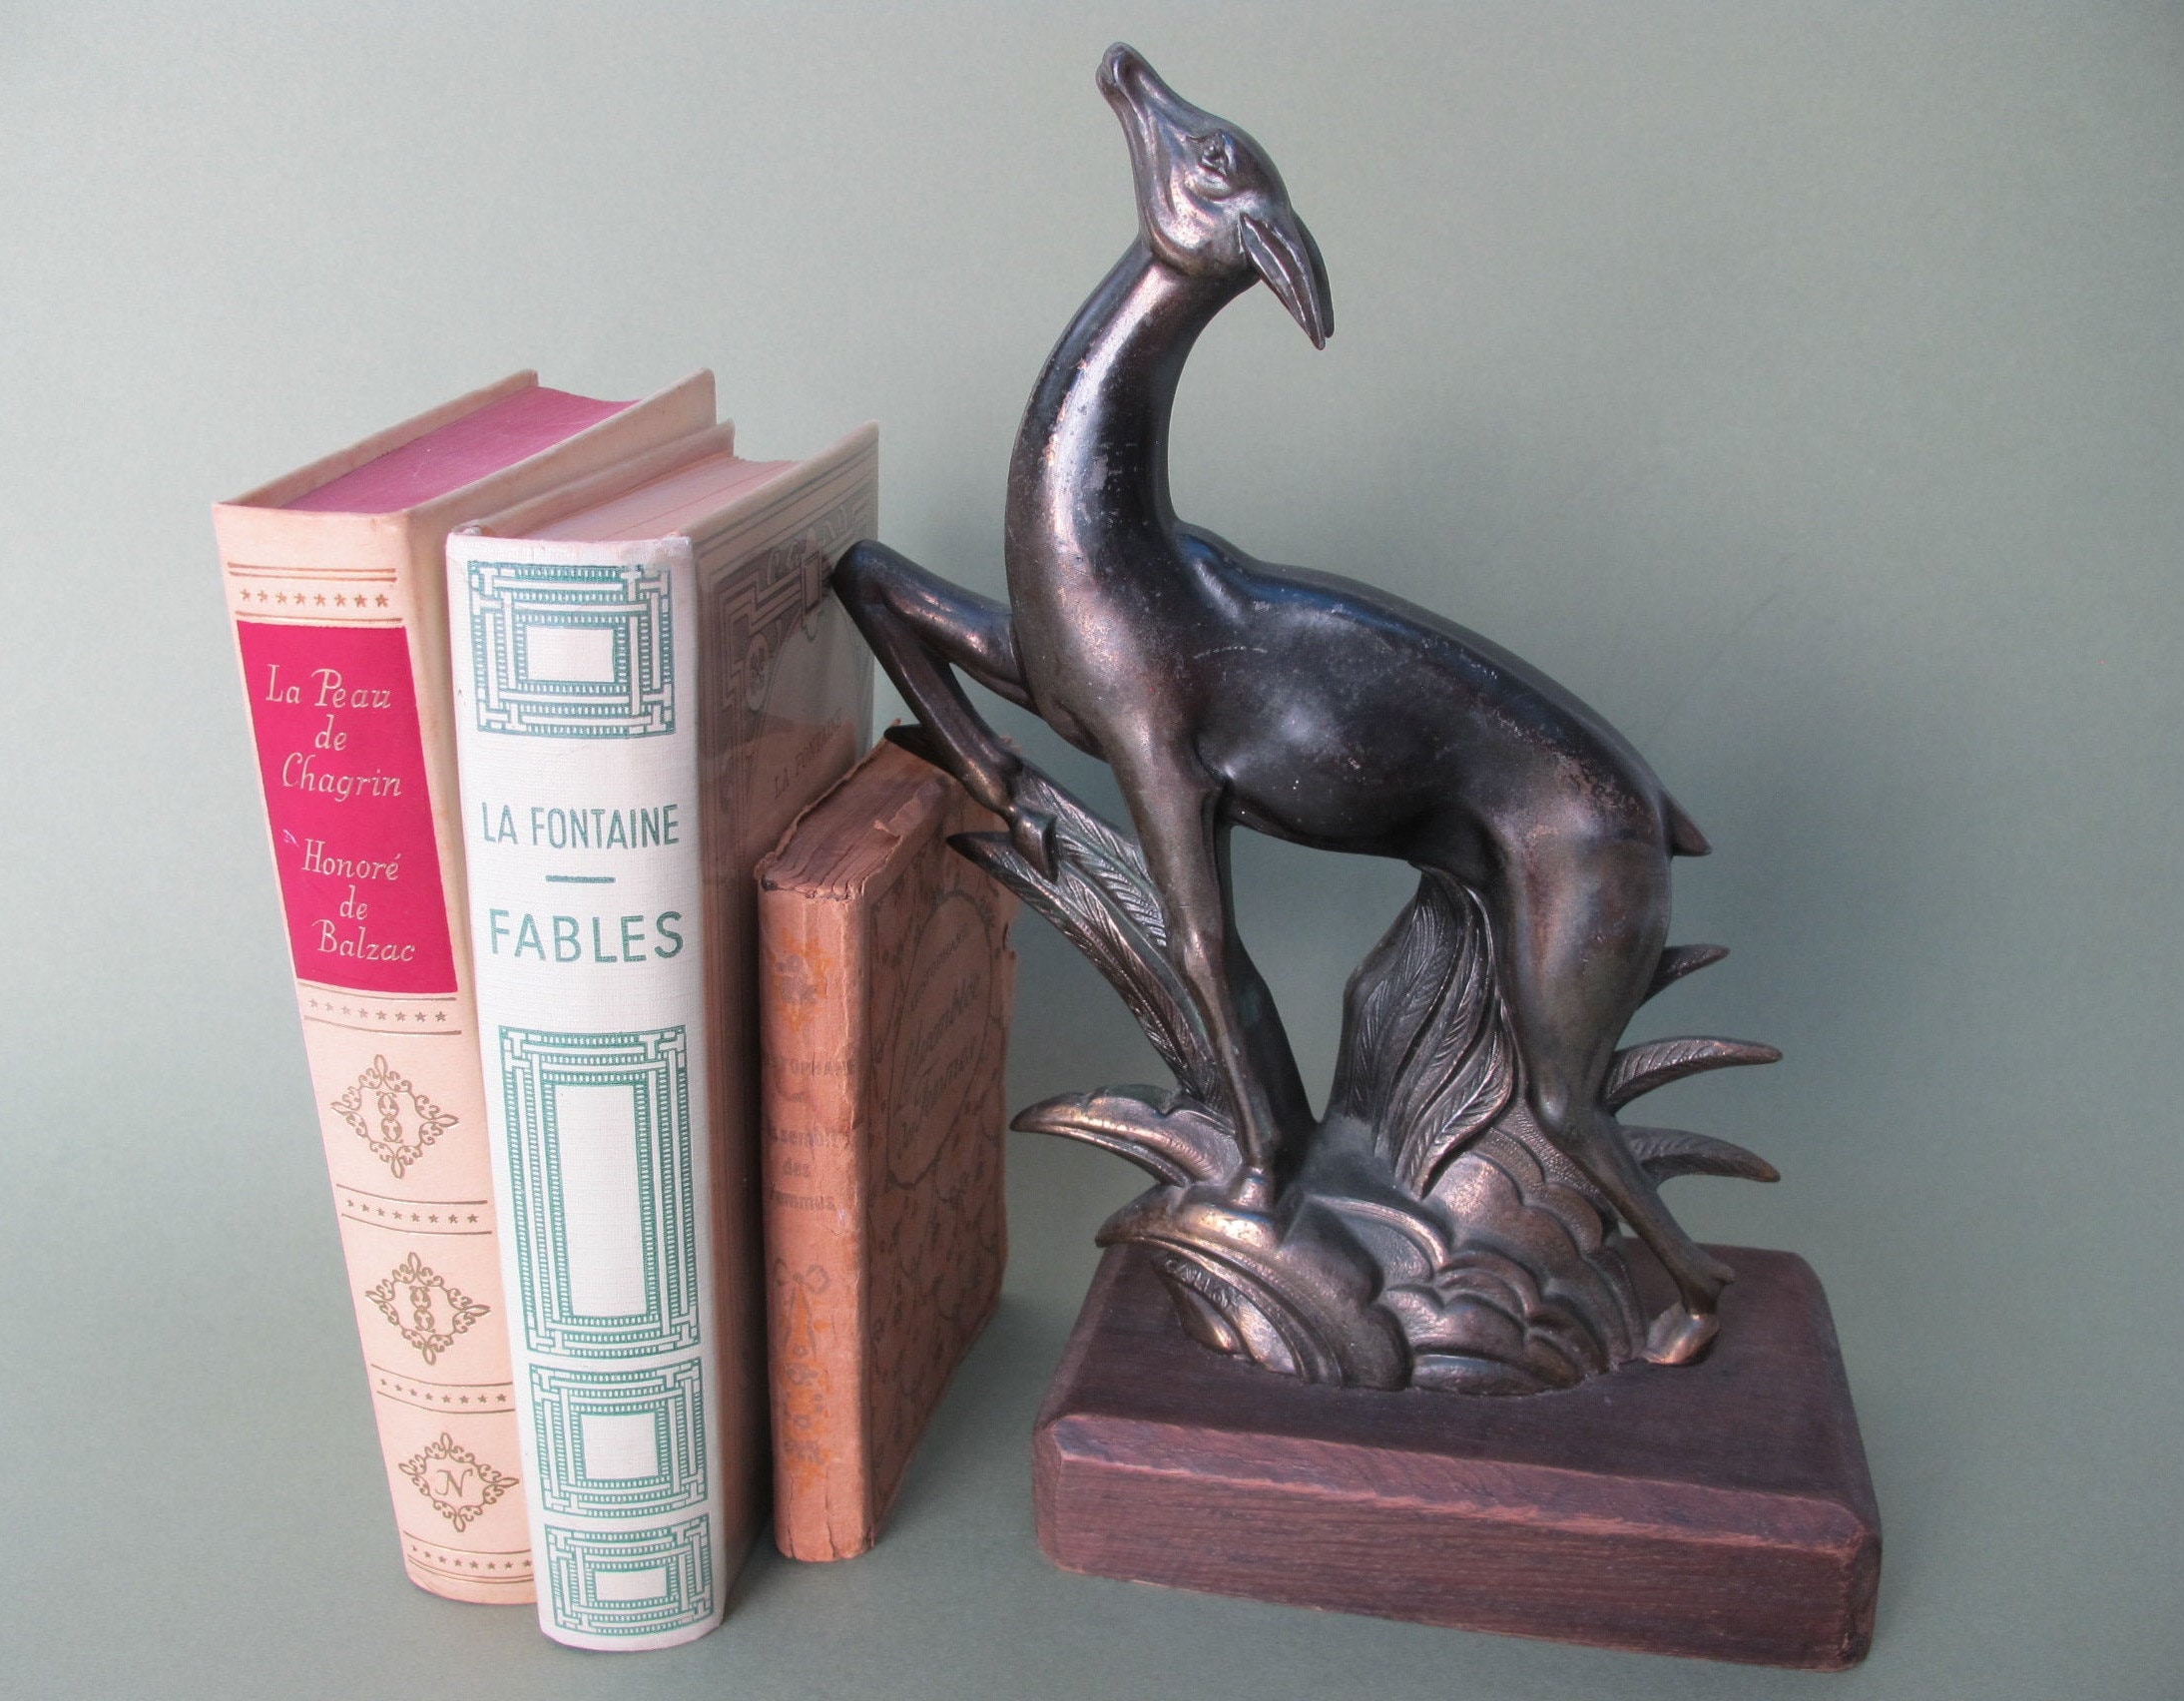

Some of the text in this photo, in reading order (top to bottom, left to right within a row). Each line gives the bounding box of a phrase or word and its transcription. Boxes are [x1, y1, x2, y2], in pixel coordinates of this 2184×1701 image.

[266, 664, 392, 709] La Peau
[314, 714, 347, 751] de
[282, 752, 402, 802] Chagrin
[481, 802, 680, 850] LA FONTAINE
[300, 838, 401, 881] Honoré
[339, 884, 368, 920] de
[311, 918, 416, 962] Balzac
[489, 907, 684, 963] FABLES
[435, 1467, 474, 1497] N
